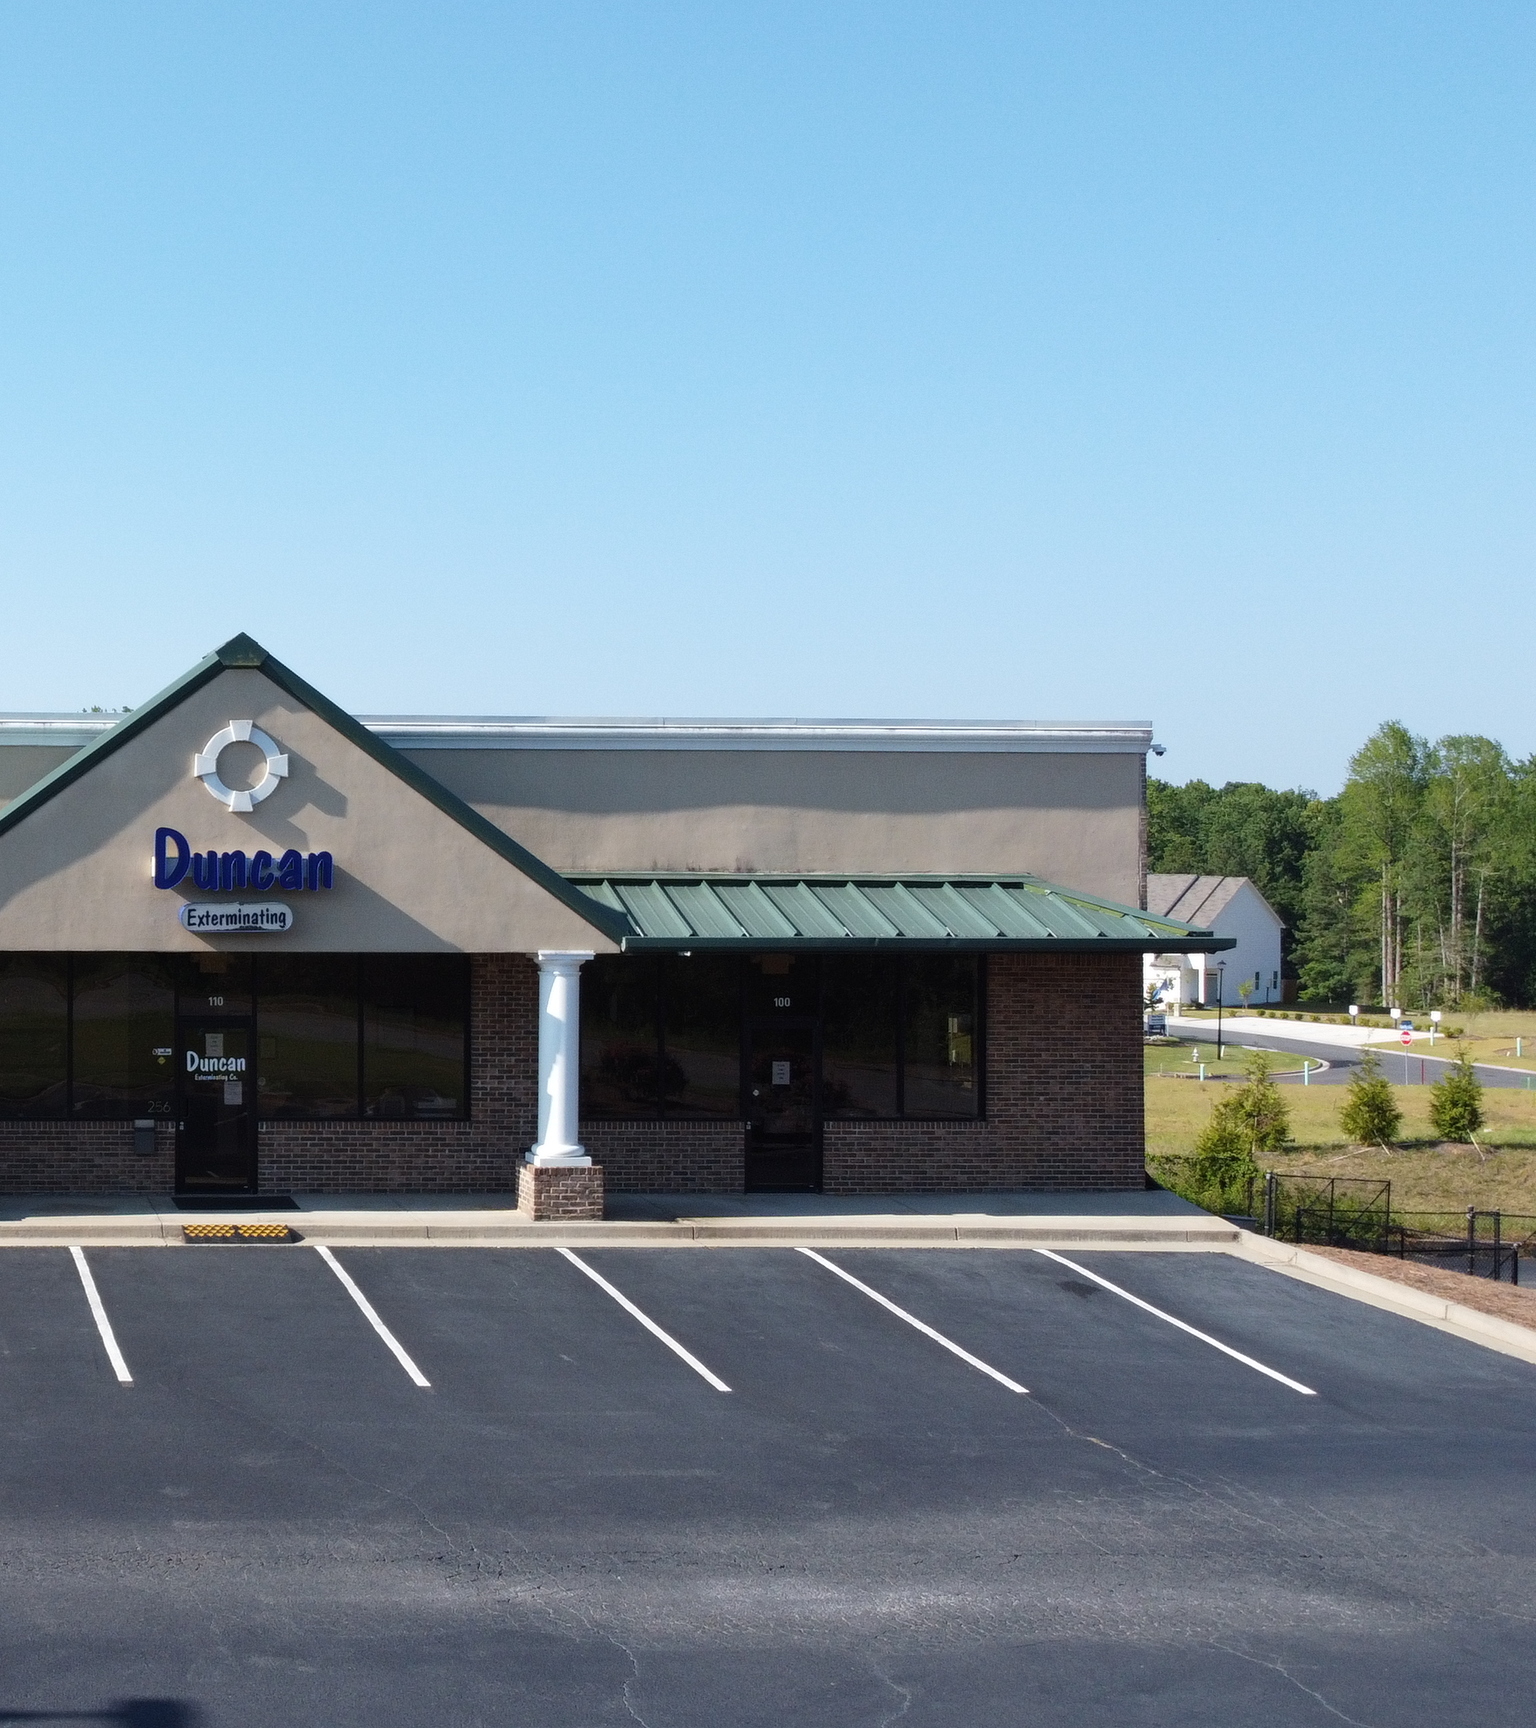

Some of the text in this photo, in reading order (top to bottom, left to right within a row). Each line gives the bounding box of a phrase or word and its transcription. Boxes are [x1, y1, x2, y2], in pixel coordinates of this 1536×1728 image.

[154, 827, 334, 891] Duncan
[187, 908, 287, 928] Exterminating
[208, 996, 224, 1006] 110
[773, 997, 791, 1007] 100
[186, 1050, 246, 1072] Duncan
[194, 1073, 228, 1081] Exterminating
[147, 1101, 171, 1113] 256
